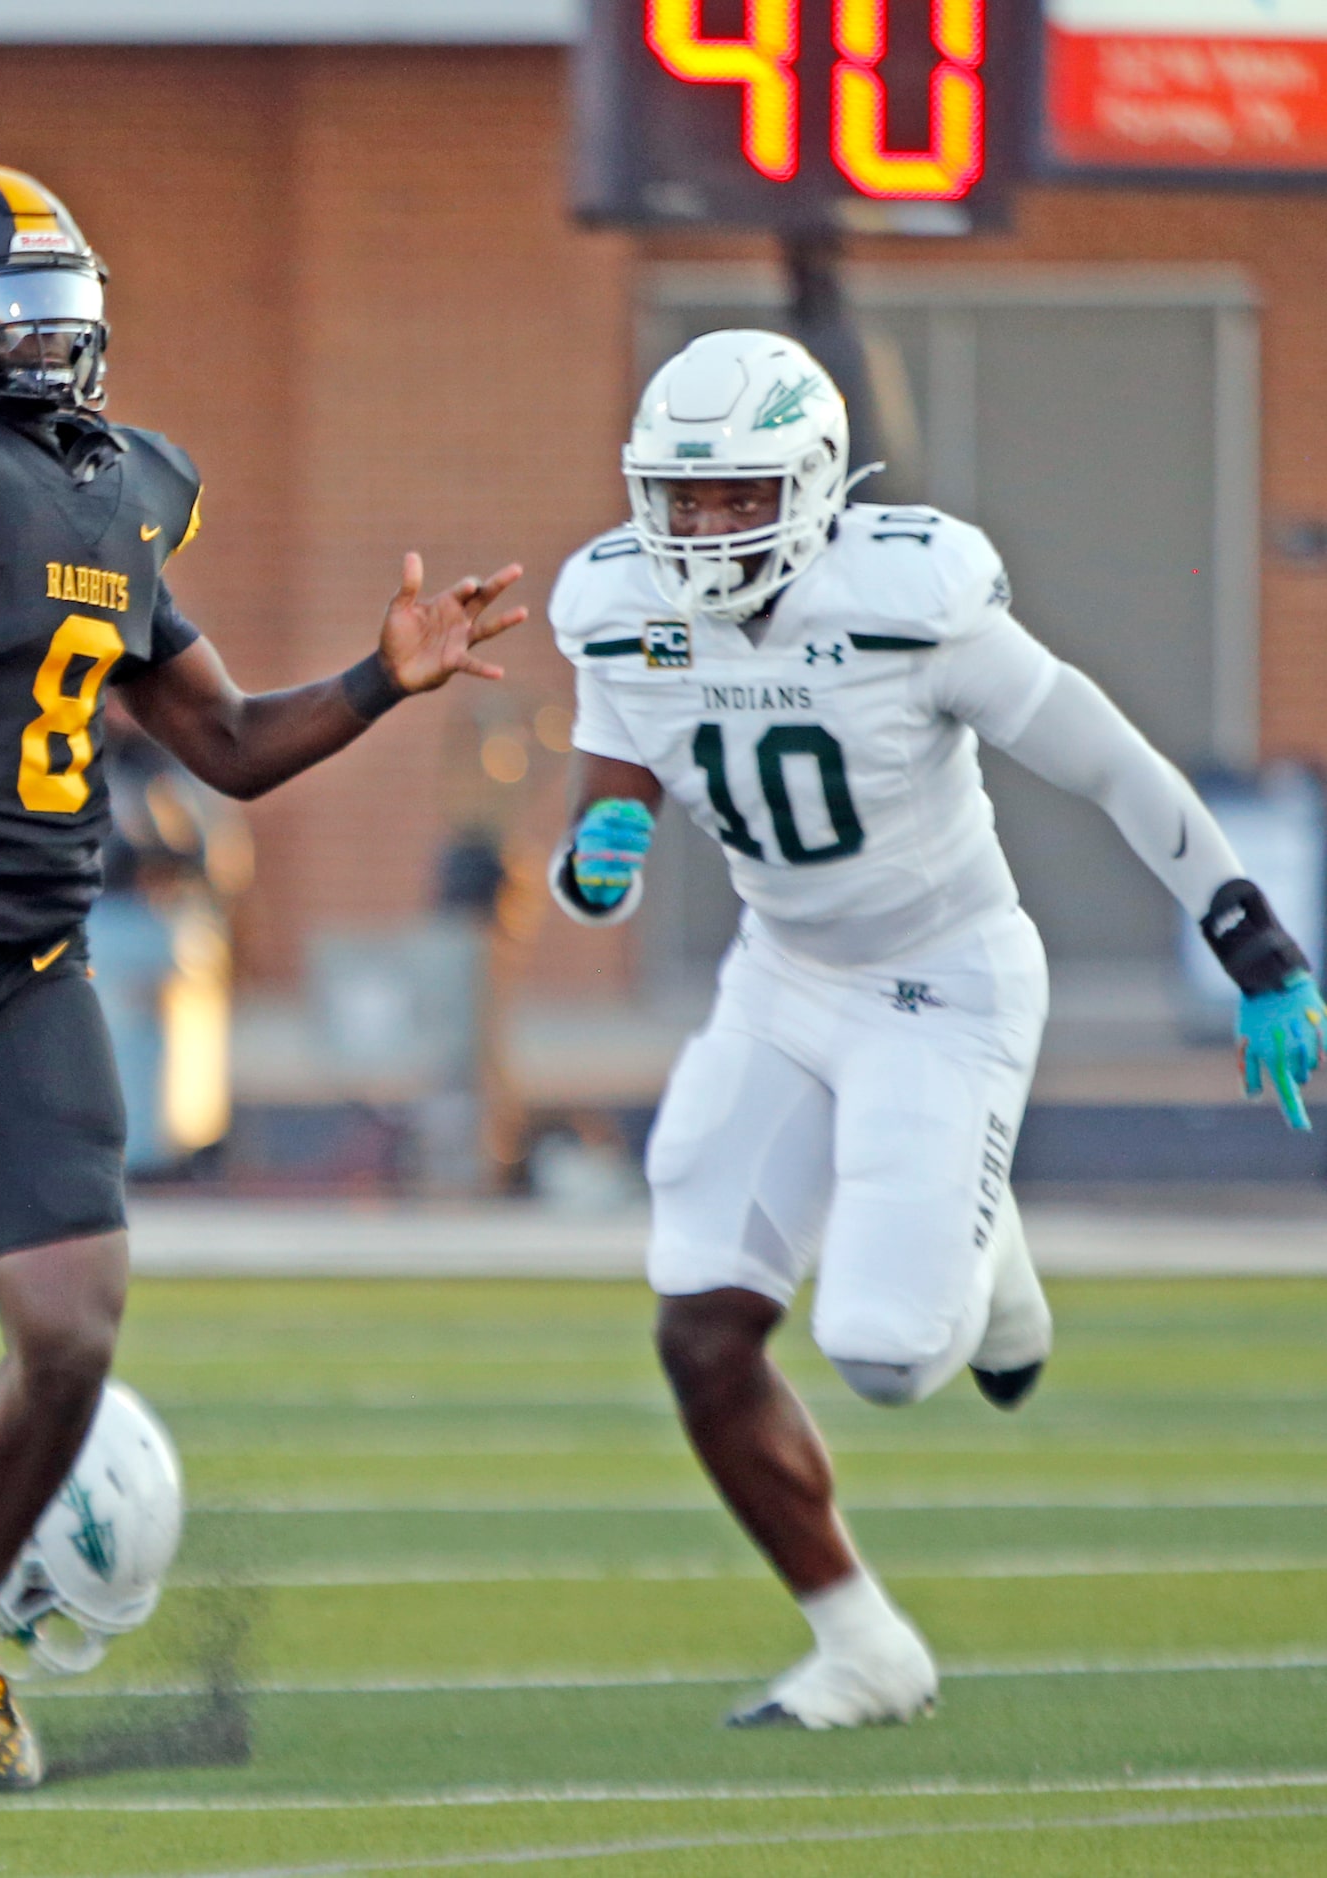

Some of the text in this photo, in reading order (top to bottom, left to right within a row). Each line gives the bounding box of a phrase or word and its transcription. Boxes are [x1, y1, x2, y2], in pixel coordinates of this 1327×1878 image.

[644, 0, 984, 200] 40
[46, 561, 129, 612] RABBITS
[17, 614, 125, 813] 8
[703, 686, 812, 710] INDIANS
[692, 723, 865, 865] 10
